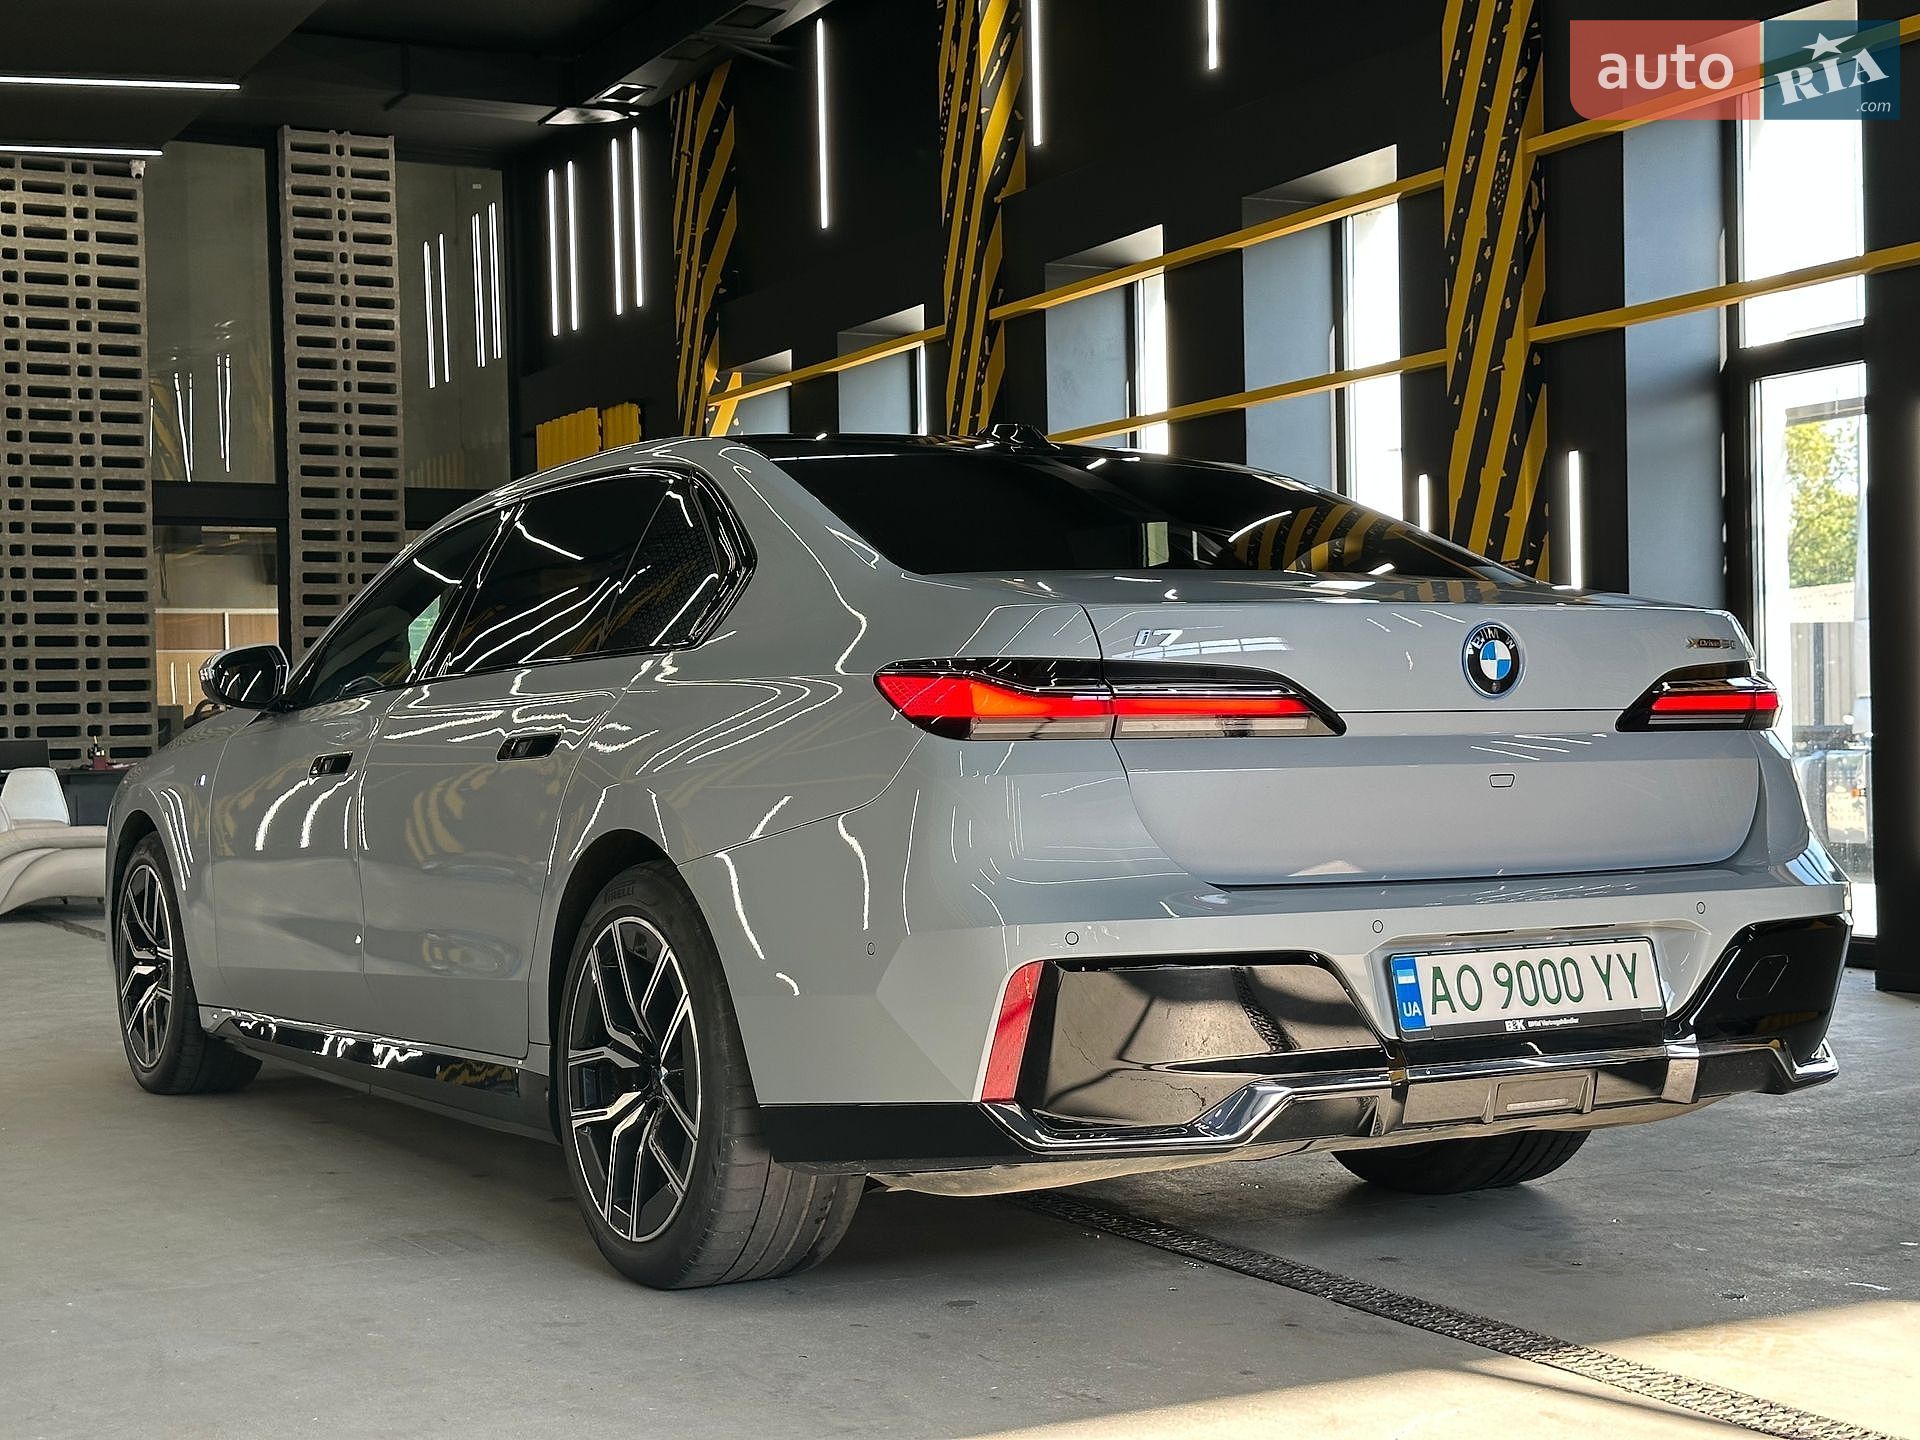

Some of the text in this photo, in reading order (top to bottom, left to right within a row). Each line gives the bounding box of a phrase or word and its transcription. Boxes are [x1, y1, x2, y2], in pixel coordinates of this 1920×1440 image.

[1133, 629, 1183, 647] i7
[1431, 952, 1637, 1015] AO 9000 YY
[1403, 1002, 1422, 1017] UA
